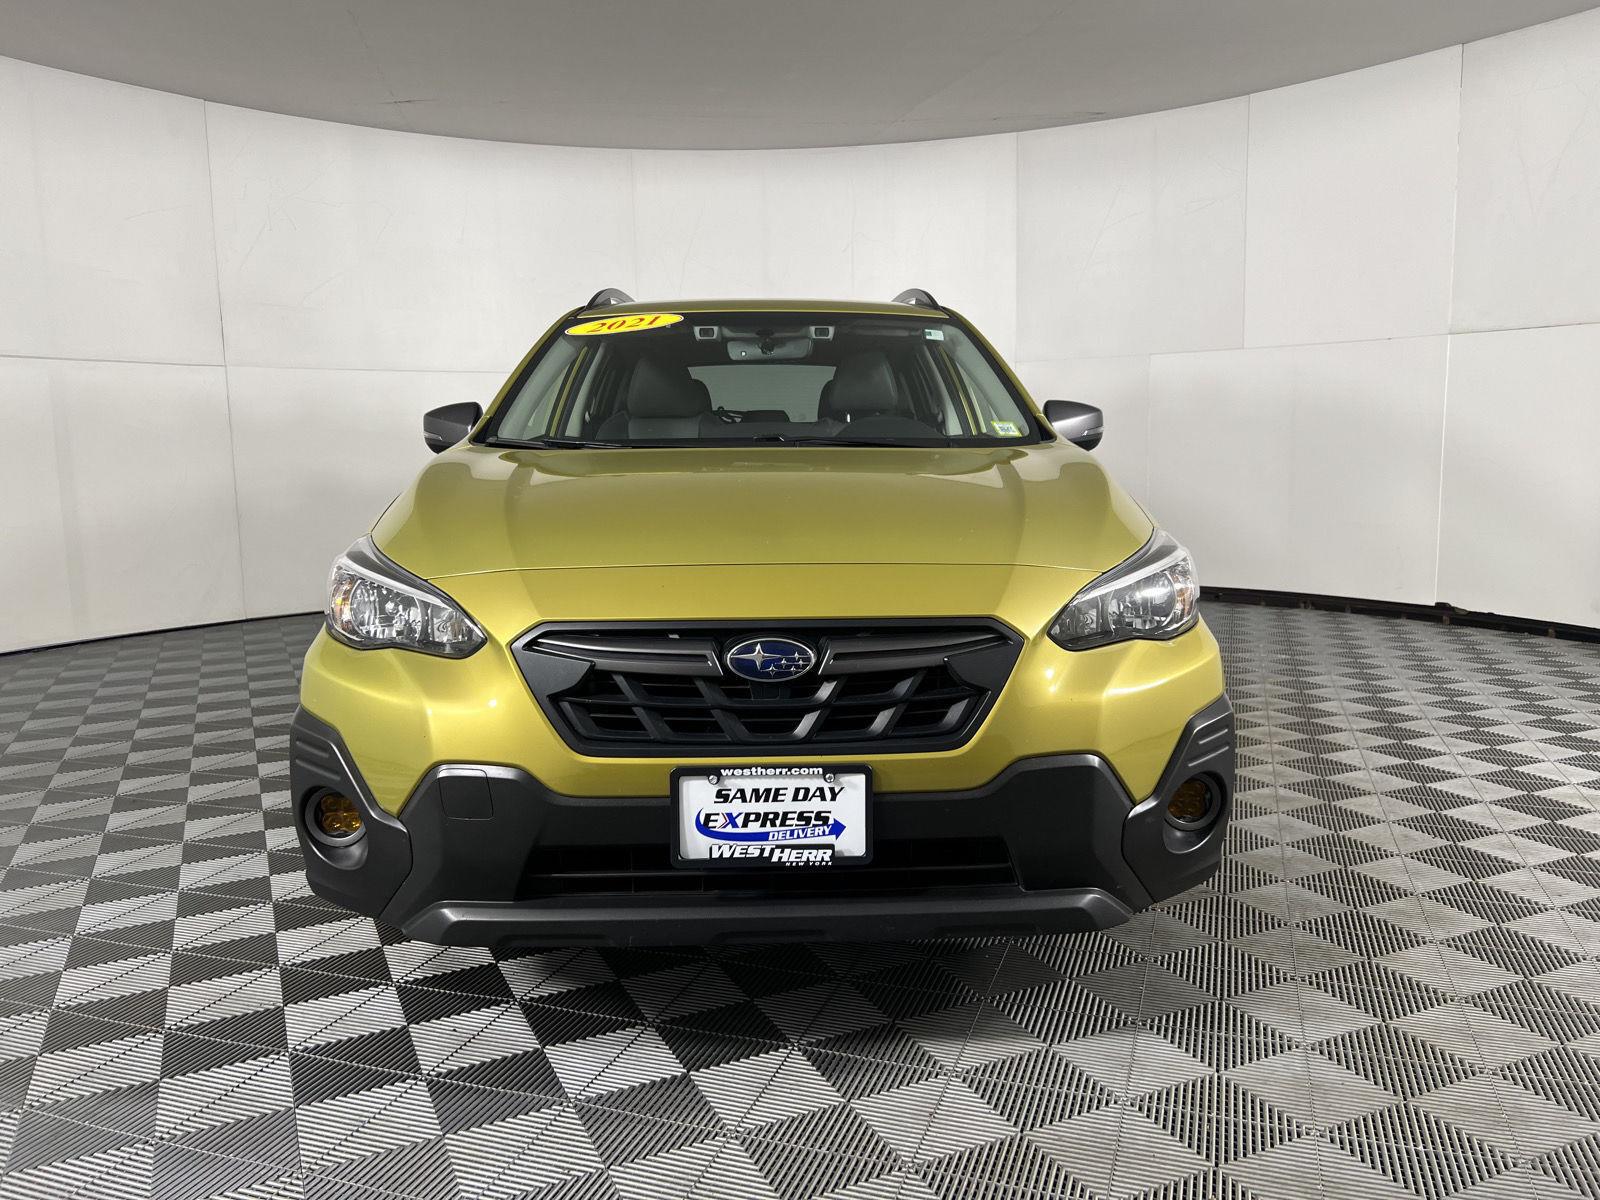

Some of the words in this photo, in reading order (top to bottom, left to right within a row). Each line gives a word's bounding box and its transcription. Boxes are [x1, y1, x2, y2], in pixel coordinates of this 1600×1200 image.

[586, 316, 661, 333] 2021
[720, 766, 823, 776] westherr.com
[714, 787, 788, 804] SAME
[793, 786, 845, 802] DAY
[703, 810, 832, 829] EXPRESS
[768, 825, 832, 841] DELIVERY
